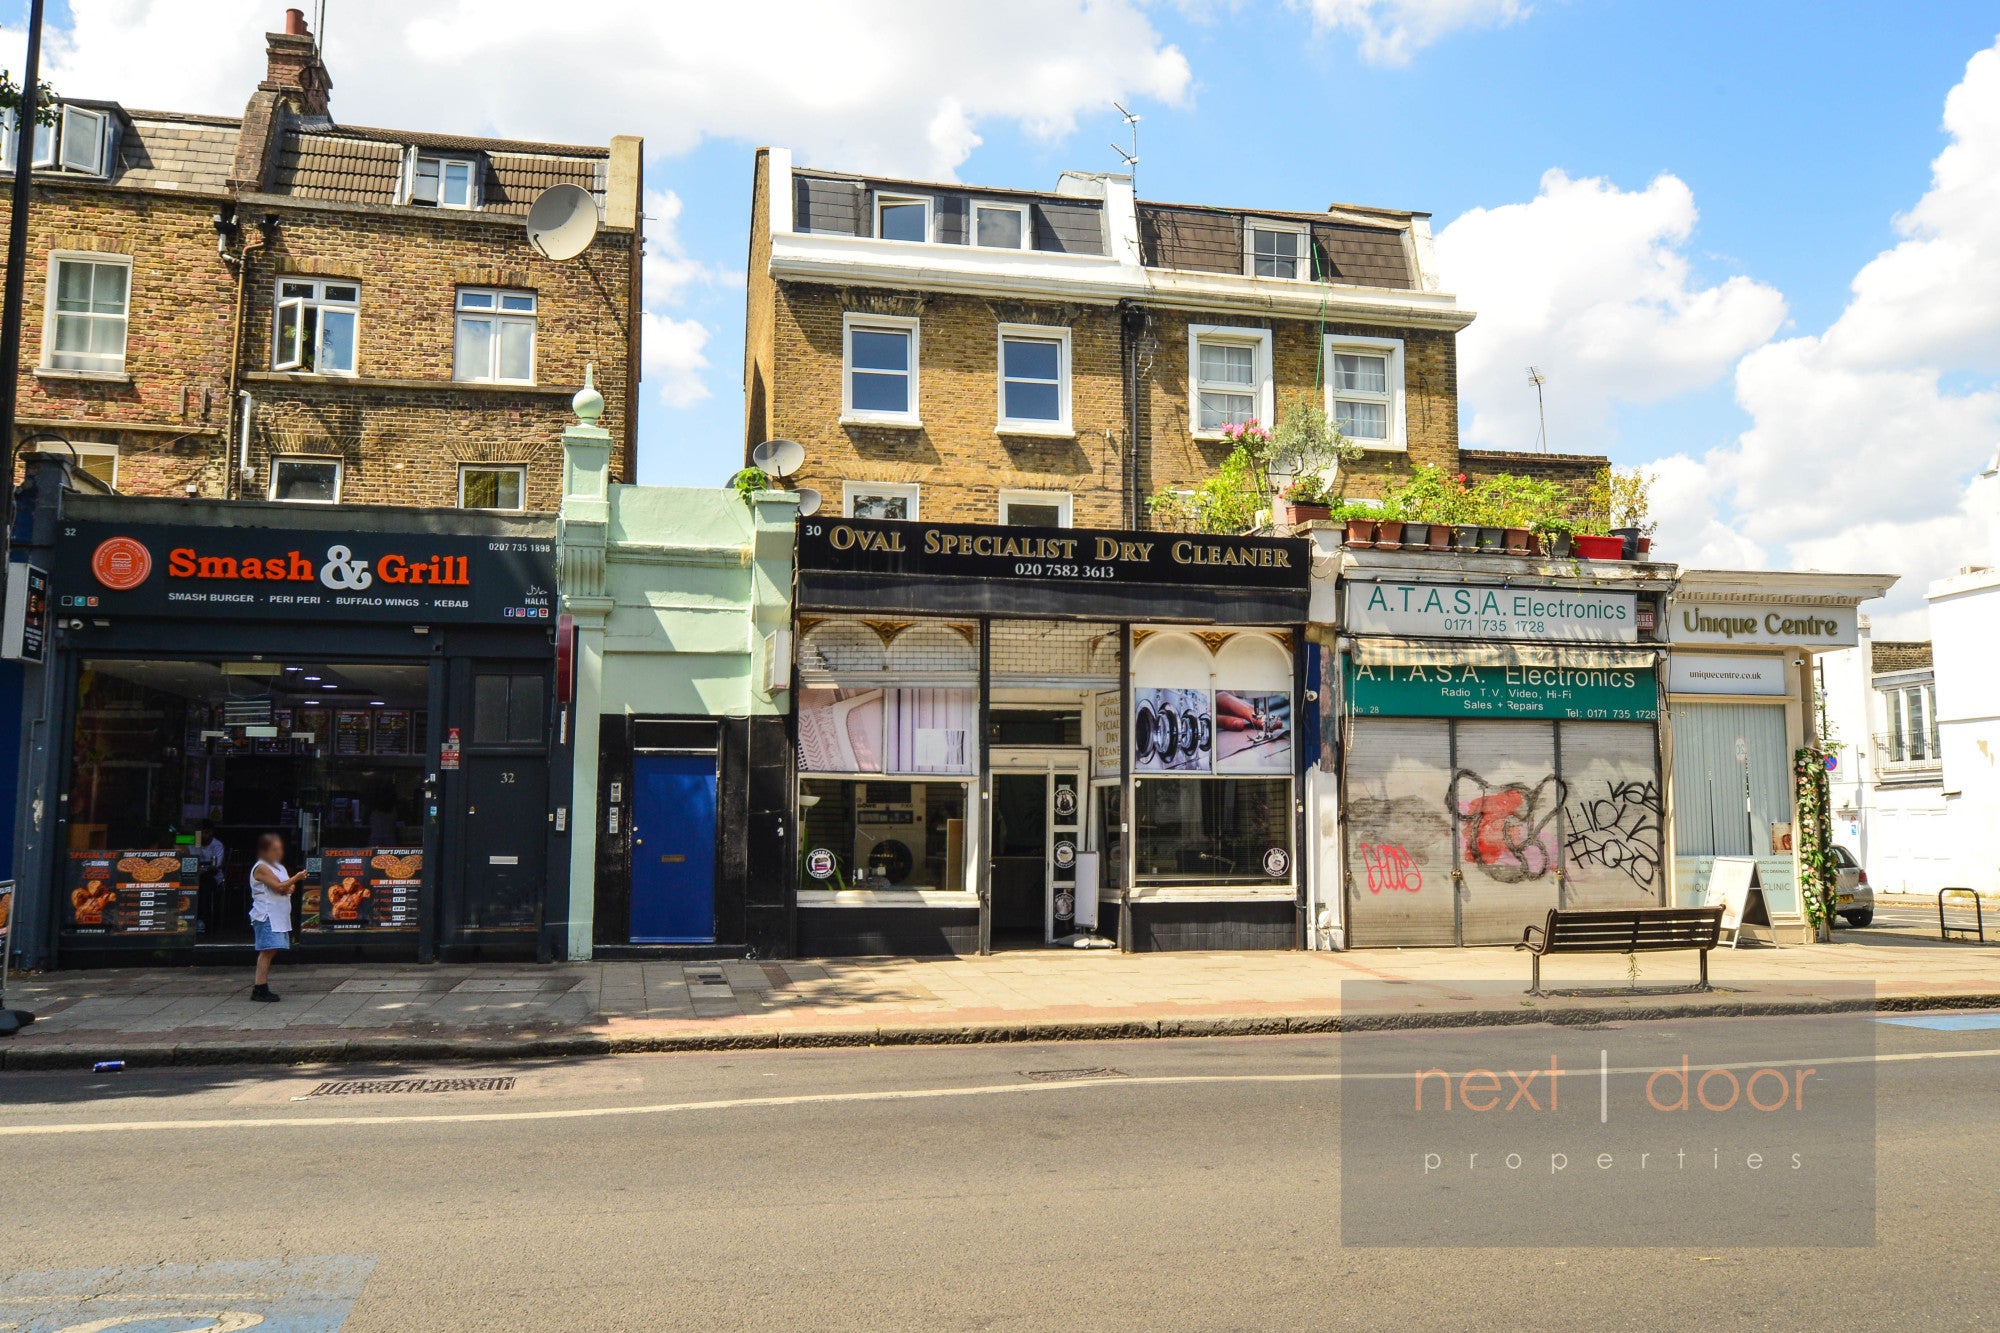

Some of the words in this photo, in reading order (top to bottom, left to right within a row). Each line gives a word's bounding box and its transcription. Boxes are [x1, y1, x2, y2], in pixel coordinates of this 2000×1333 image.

[64, 528, 76, 536] 32
[806, 525, 822, 536] 30
[489, 543, 509, 551] 0207
[512, 543, 527, 552] 735
[530, 544, 551, 553] 1898
[829, 525, 906, 552] OVAL
[924, 529, 1078, 559] SPECIALIST
[1095, 536, 1154, 562] DRY
[1171, 540, 1292, 568] CLEANER
[168, 547, 315, 582] Smash
[319, 544, 372, 591] &
[377, 554, 470, 586] Grill
[1015, 562, 1041, 575] 020
[1046, 564, 1078, 577] 7582
[1082, 565, 1114, 578] 3613
[168, 592, 206, 602] SMASH
[209, 593, 254, 603] BURGER
[269, 595, 293, 604] PERI
[296, 596, 321, 604] PERI
[336, 596, 382, 606] BUFFALO
[385, 597, 419, 607] WINGS
[434, 599, 469, 608] KEBAB
[525, 598, 549, 606] HALAL
[1367, 586, 1507, 616] A.T.A.S.A.
[1513, 596, 1627, 620] Electronics
[1444, 618, 1473, 631] 0171
[1482, 619, 1507, 632] 735
[1515, 620, 1545, 633] 1728
[1683, 607, 1758, 639] Unique
[1764, 612, 1838, 637] Centre
[1505, 665, 1636, 688] Electronics
[1689, 670, 1762, 681] uniquecentre.co.uk
[1441, 687, 1471, 697] Radio
[1546, 690, 1572, 700] Hi-Fi
[1370, 706, 1380, 714] 28
[1463, 700, 1492, 710] Sales
[1507, 700, 1544, 712] Repairs
[1565, 708, 1582, 718] Tel:
[1587, 709, 1607, 719] 0171
[1613, 709, 1630, 719] 735
[1635, 710, 1657, 720] 1728
[1096, 720, 1120, 731] SPECIAL
[1106, 732, 1119, 743] DRY
[1098, 746, 1121, 757] CLEANE
[500, 772, 515, 784] 32
[1680, 883, 1708, 893] UNIQU
[1764, 882, 1791, 892] CLINIC
